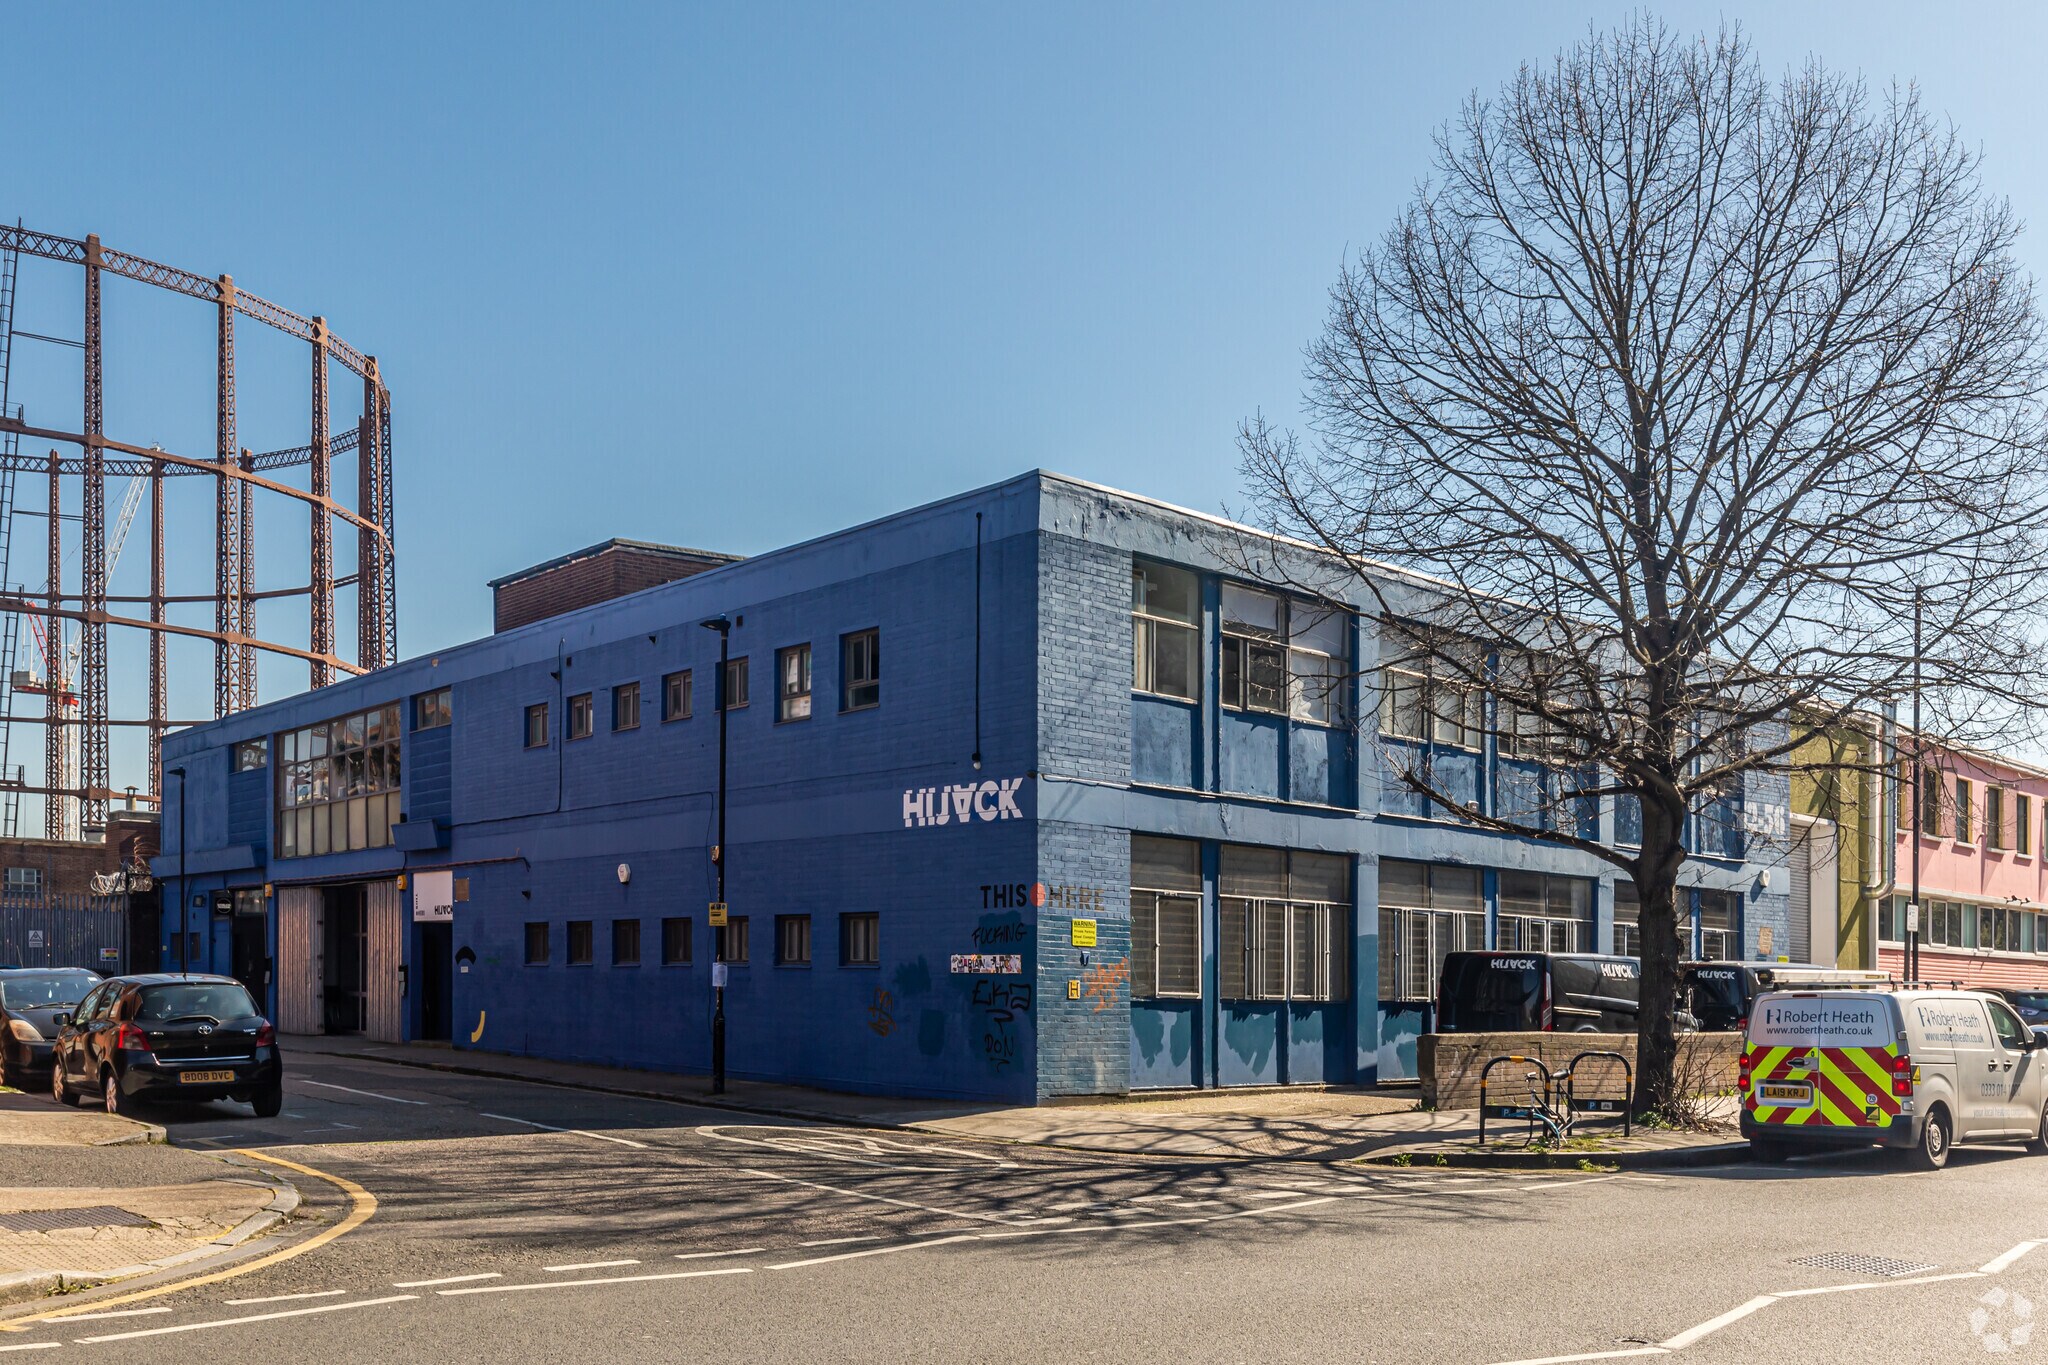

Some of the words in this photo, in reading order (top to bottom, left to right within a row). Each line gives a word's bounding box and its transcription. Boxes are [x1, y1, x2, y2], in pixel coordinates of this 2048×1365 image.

[903, 777, 1023, 827] HIJACK
[980, 884, 1027, 909] THIS
[1048, 885, 1105, 911] HERE
[971, 923, 1027, 947] FUCKING
[1491, 958, 1536, 970] HIJACK
[1600, 963, 1634, 978] HIJACK
[1697, 969, 1735, 980] HIJACK
[1069, 982, 1079, 998] H
[1784, 1011, 1828, 1023] Robert
[1832, 1011, 1874, 1024] Heath
[1930, 1010, 1958, 1026] Robert
[1957, 1012, 1981, 1028] Heath
[1766, 1025, 1873, 1036] www.robertheath.co.uk
[184, 1071, 209, 1081] BD08
[212, 1071, 230, 1081] DVC
[1766, 1087, 1786, 1097] LA19
[1788, 1088, 1805, 1098] KRJ
